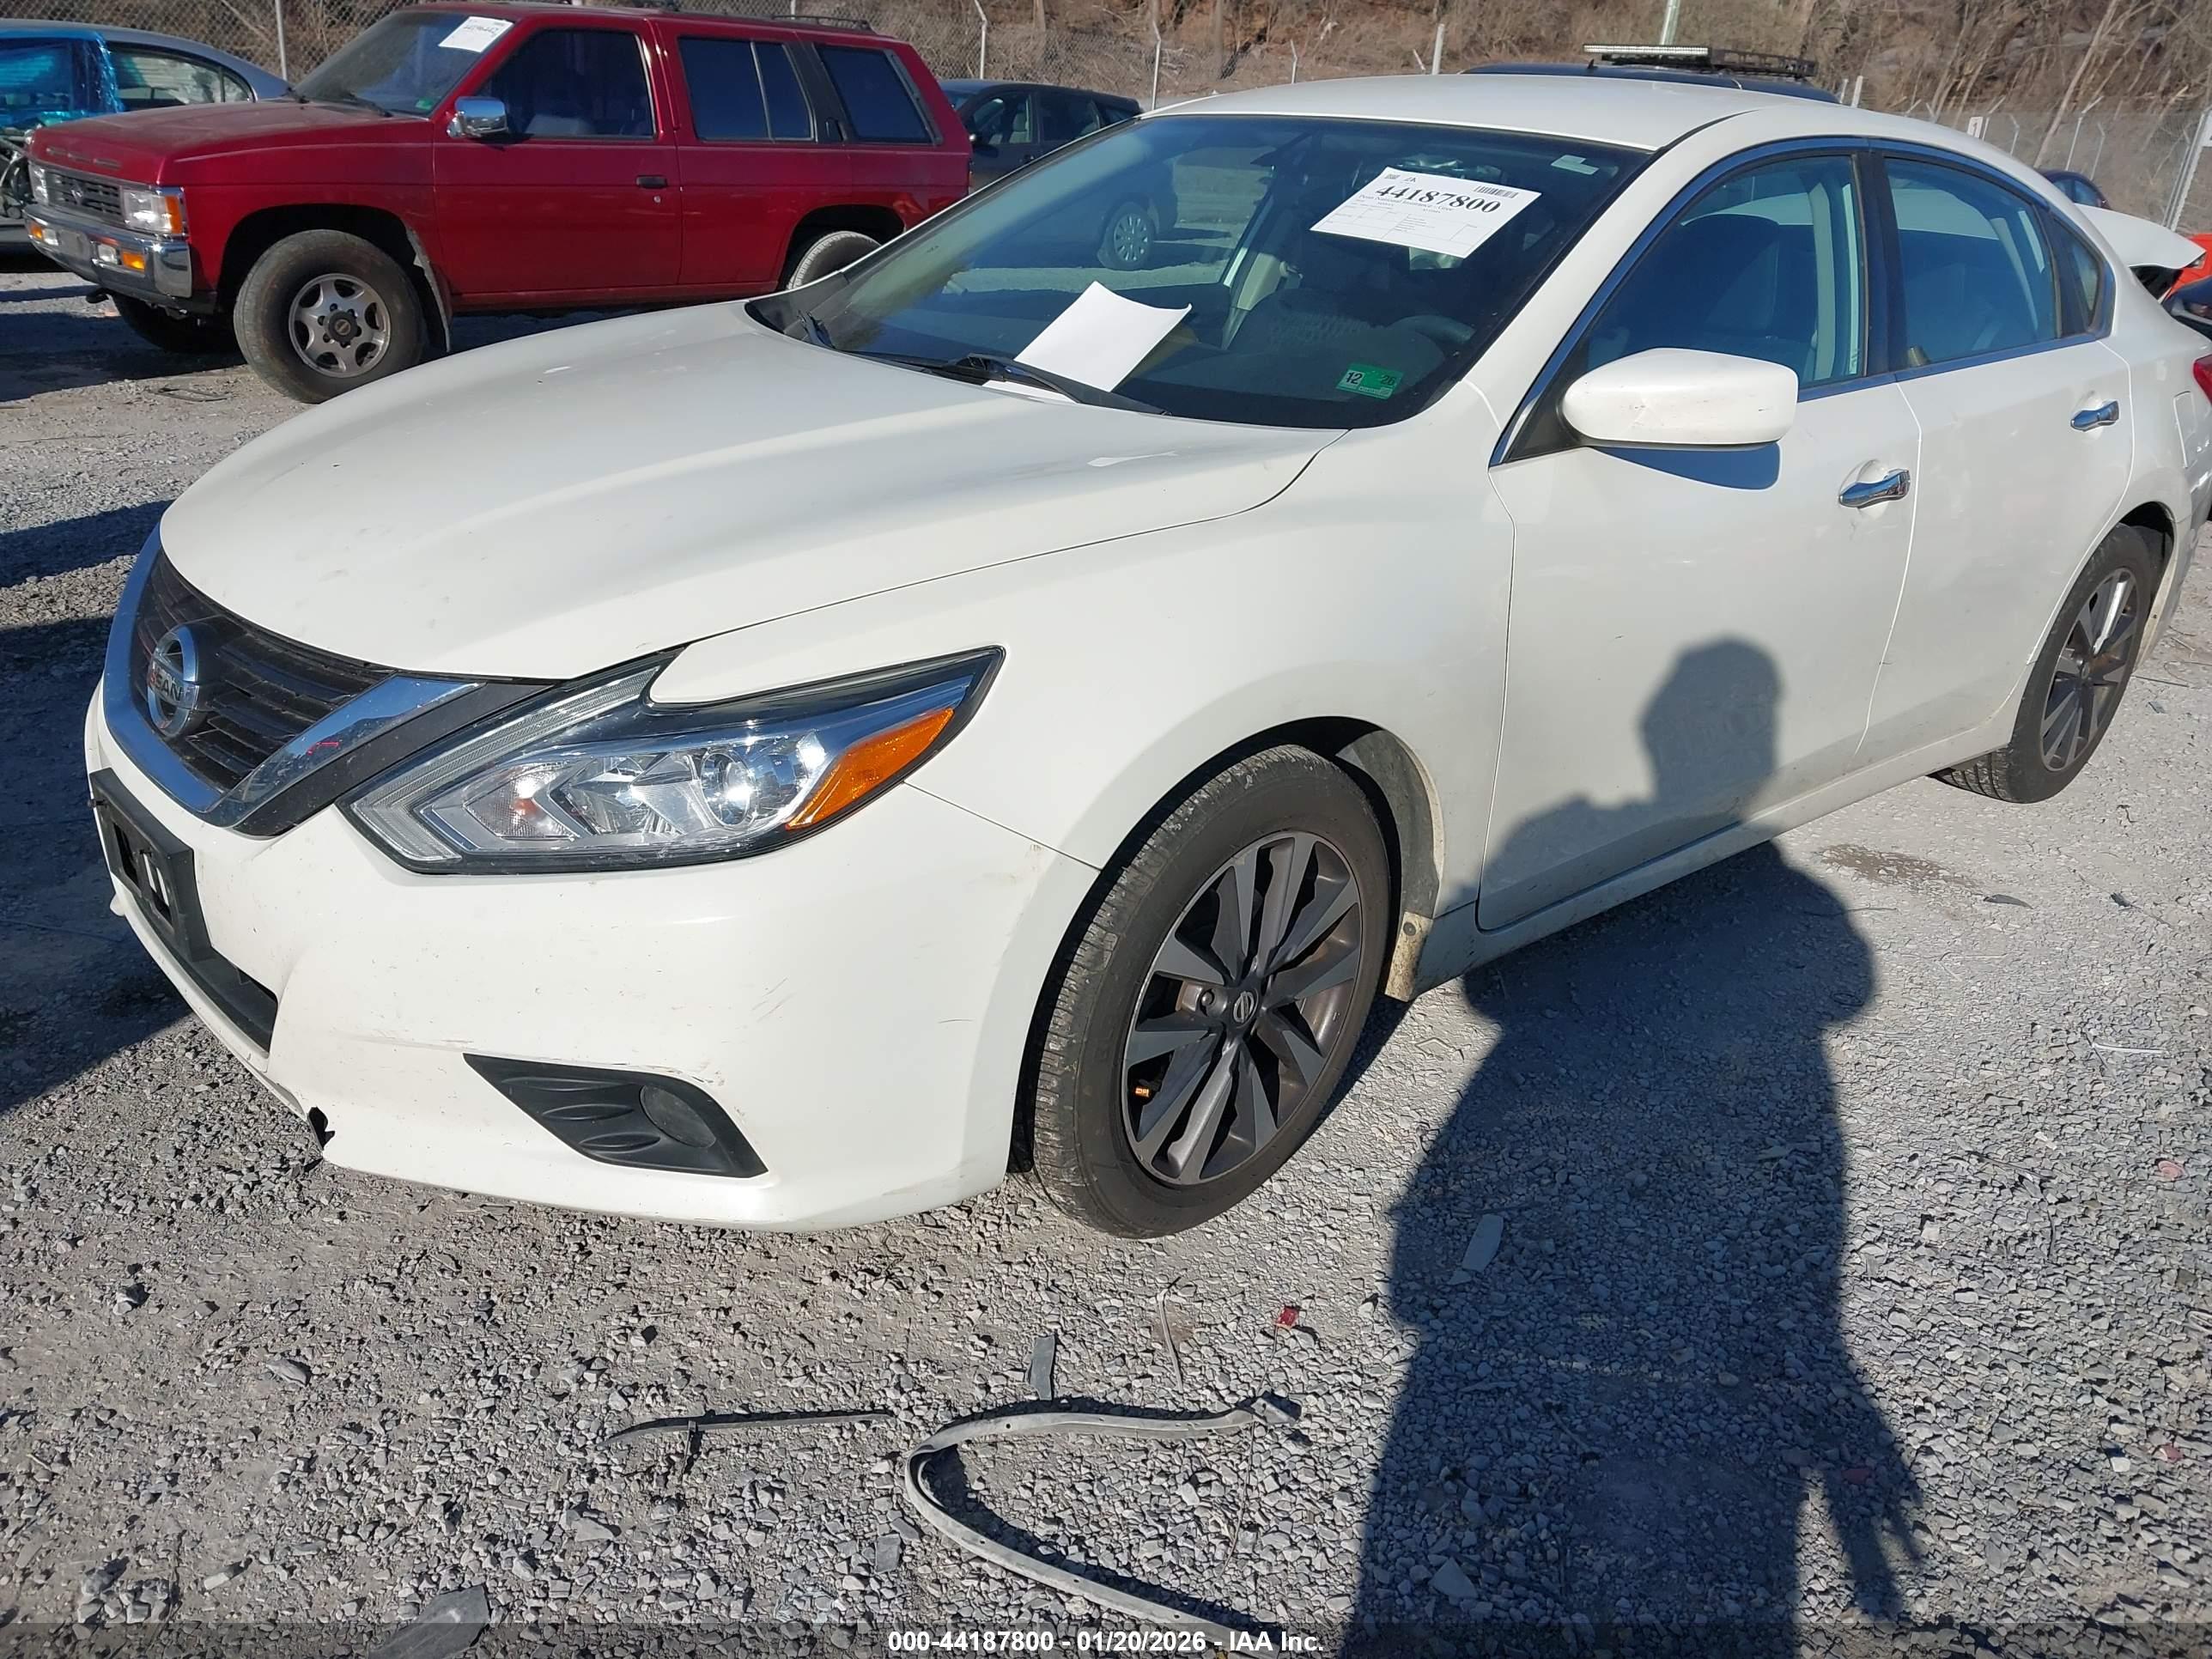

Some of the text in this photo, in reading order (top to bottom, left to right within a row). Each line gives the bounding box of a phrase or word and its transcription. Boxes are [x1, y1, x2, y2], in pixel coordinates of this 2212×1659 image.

[1375, 185, 1502, 214] 44187800
[1346, 372, 1395, 386] 12 26
